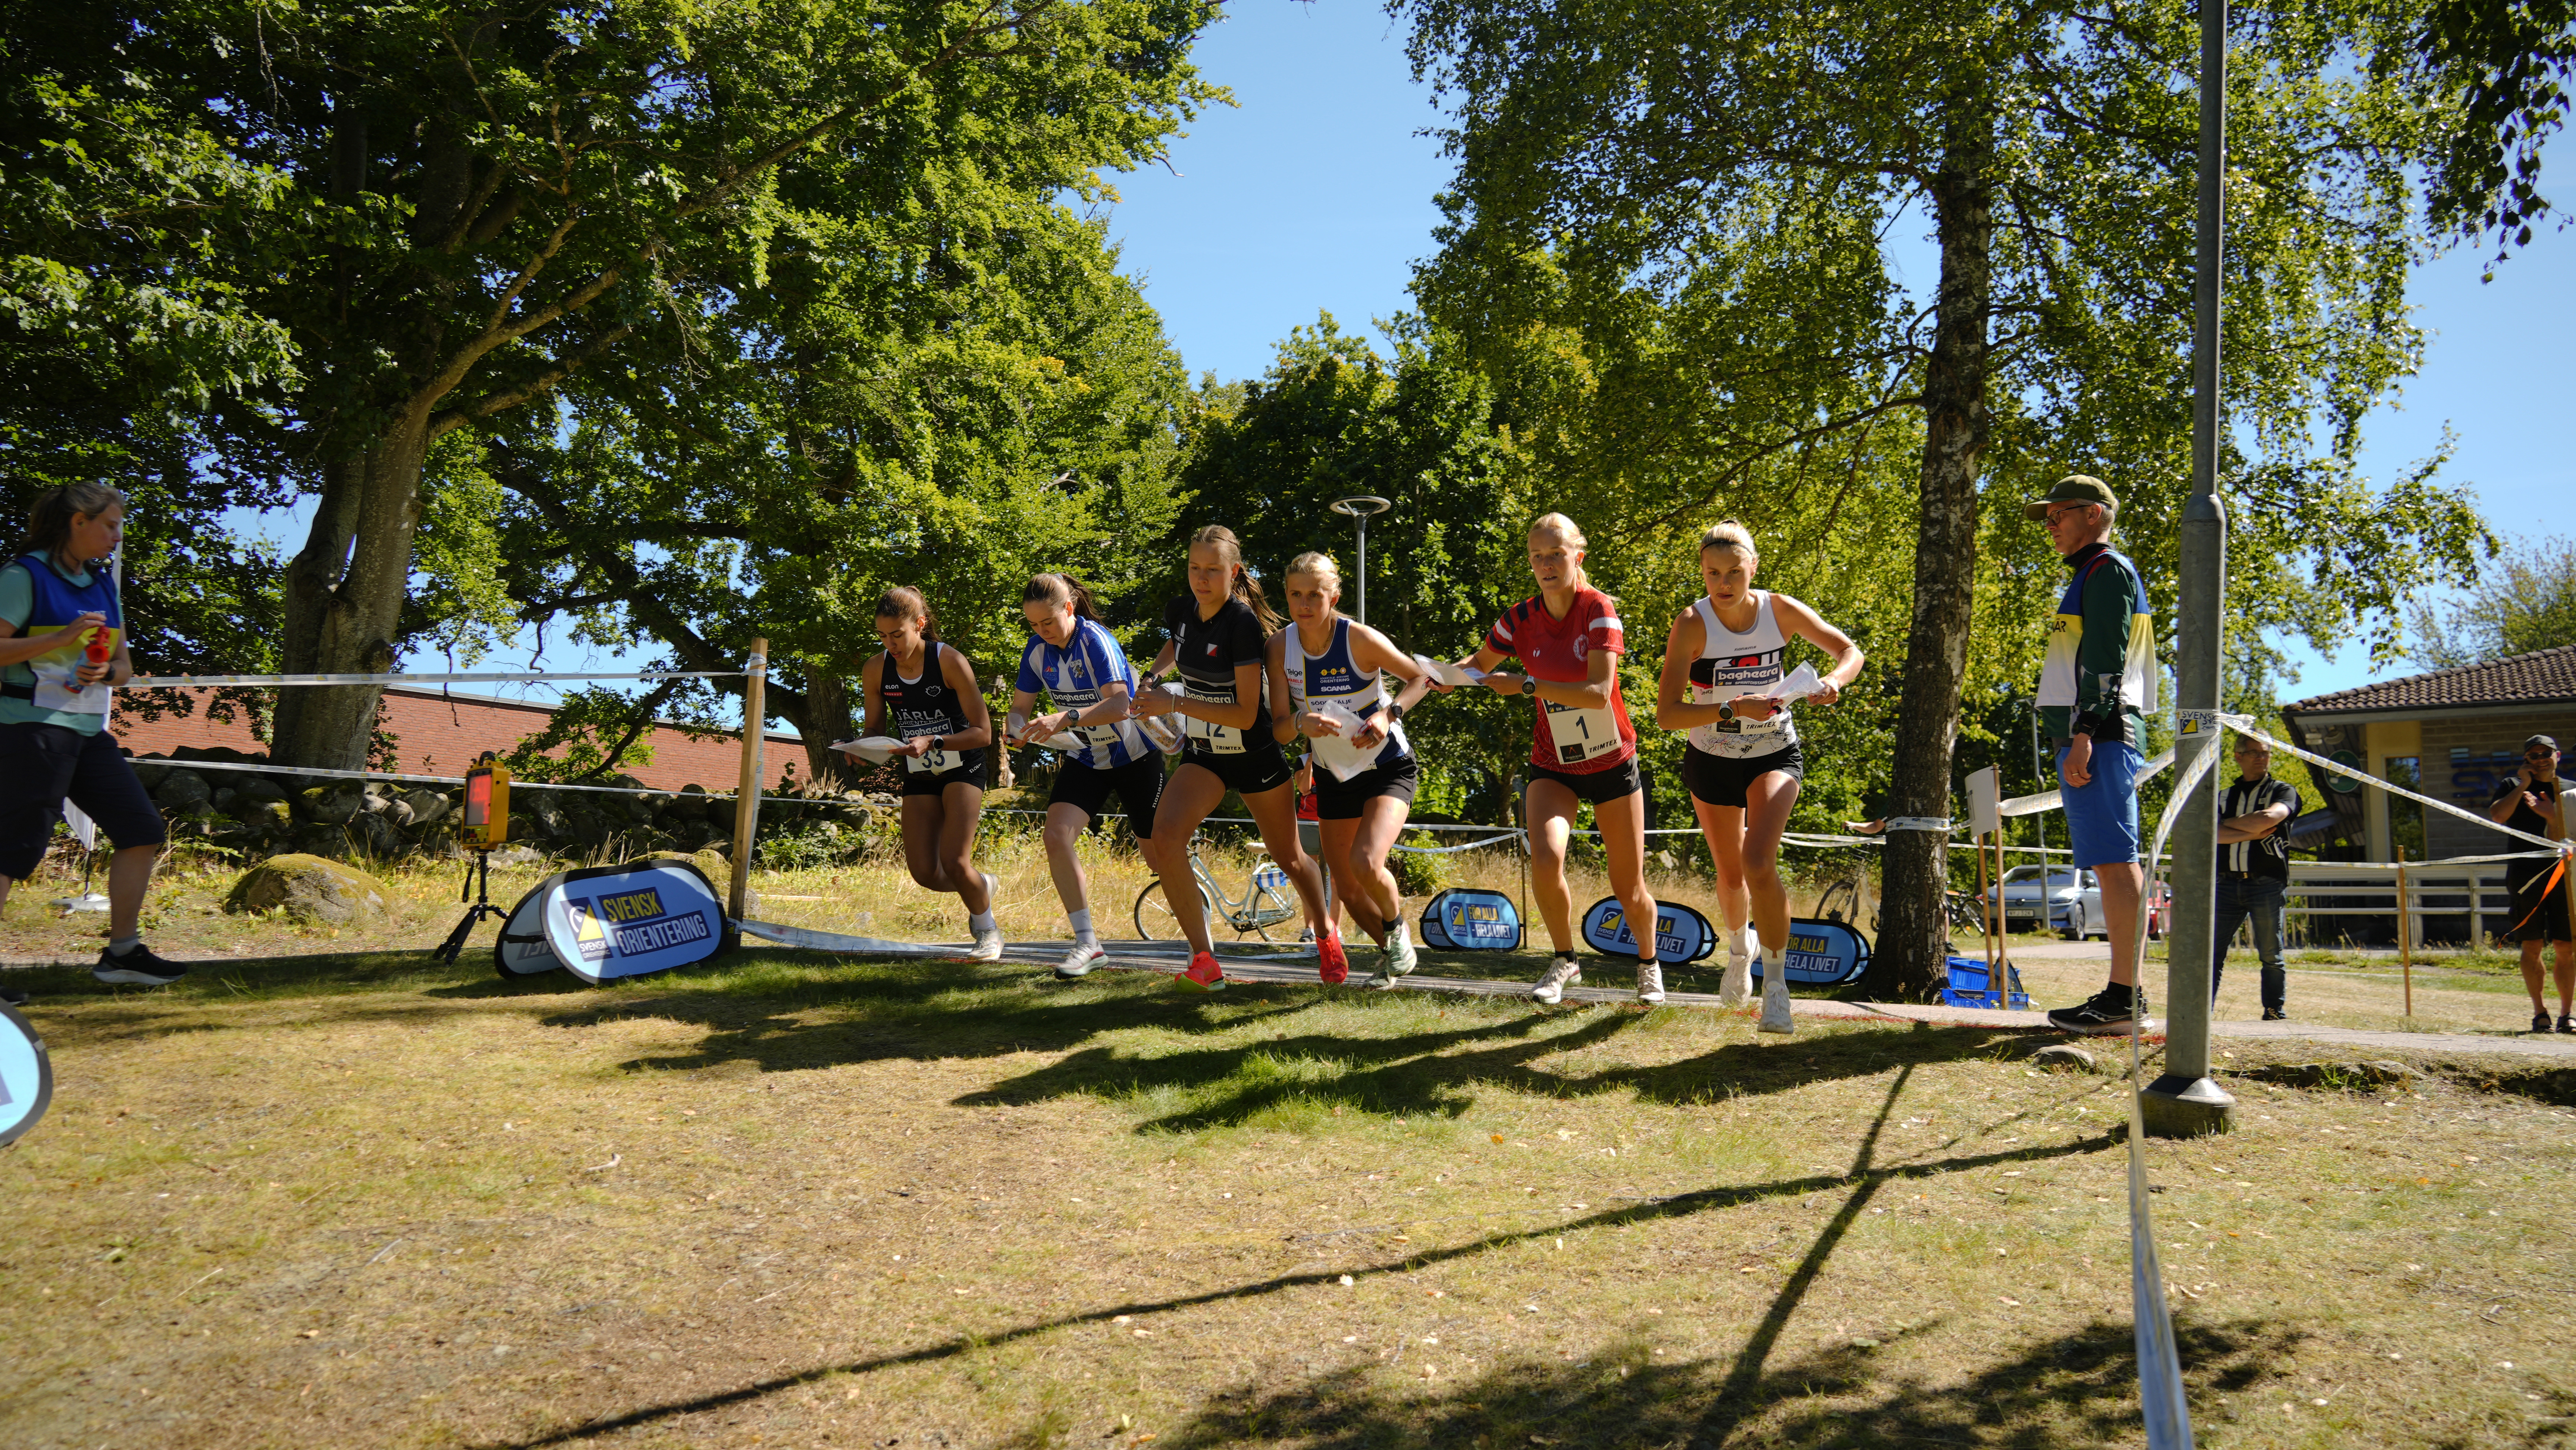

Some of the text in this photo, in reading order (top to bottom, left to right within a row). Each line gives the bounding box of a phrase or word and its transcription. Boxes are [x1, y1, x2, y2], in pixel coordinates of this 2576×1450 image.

[1287, 668, 1303, 676] Telge
[1718, 667, 1778, 680] bagheera
[1052, 693, 1095, 702] bagheera
[1185, 689, 1231, 704] bagheera
[897, 709, 945, 721] JÄRLA
[904, 723, 949, 736] bagheera
[1576, 715, 1589, 740] 1
[1746, 721, 1777, 730] TRIMTEX
[1589, 739, 1617, 753] TRIMTEX
[1152, 773, 1163, 808] noname
[602, 892, 663, 922] SVENSK
[1468, 905, 1499, 921] FÖR ALLA
[1475, 924, 1493, 937] HELA
[1493, 925, 1511, 938] LIVET
[1598, 927, 1615, 935] SVENSK
[1656, 918, 1671, 933] LA
[616, 914, 707, 954] ORIENTERING
[579, 940, 608, 952] SVENSK
[1656, 935, 1684, 953] LIVET
[1787, 934, 1825, 953] ÖR ALLA
[1785, 954, 1838, 972] HELA LIVET
